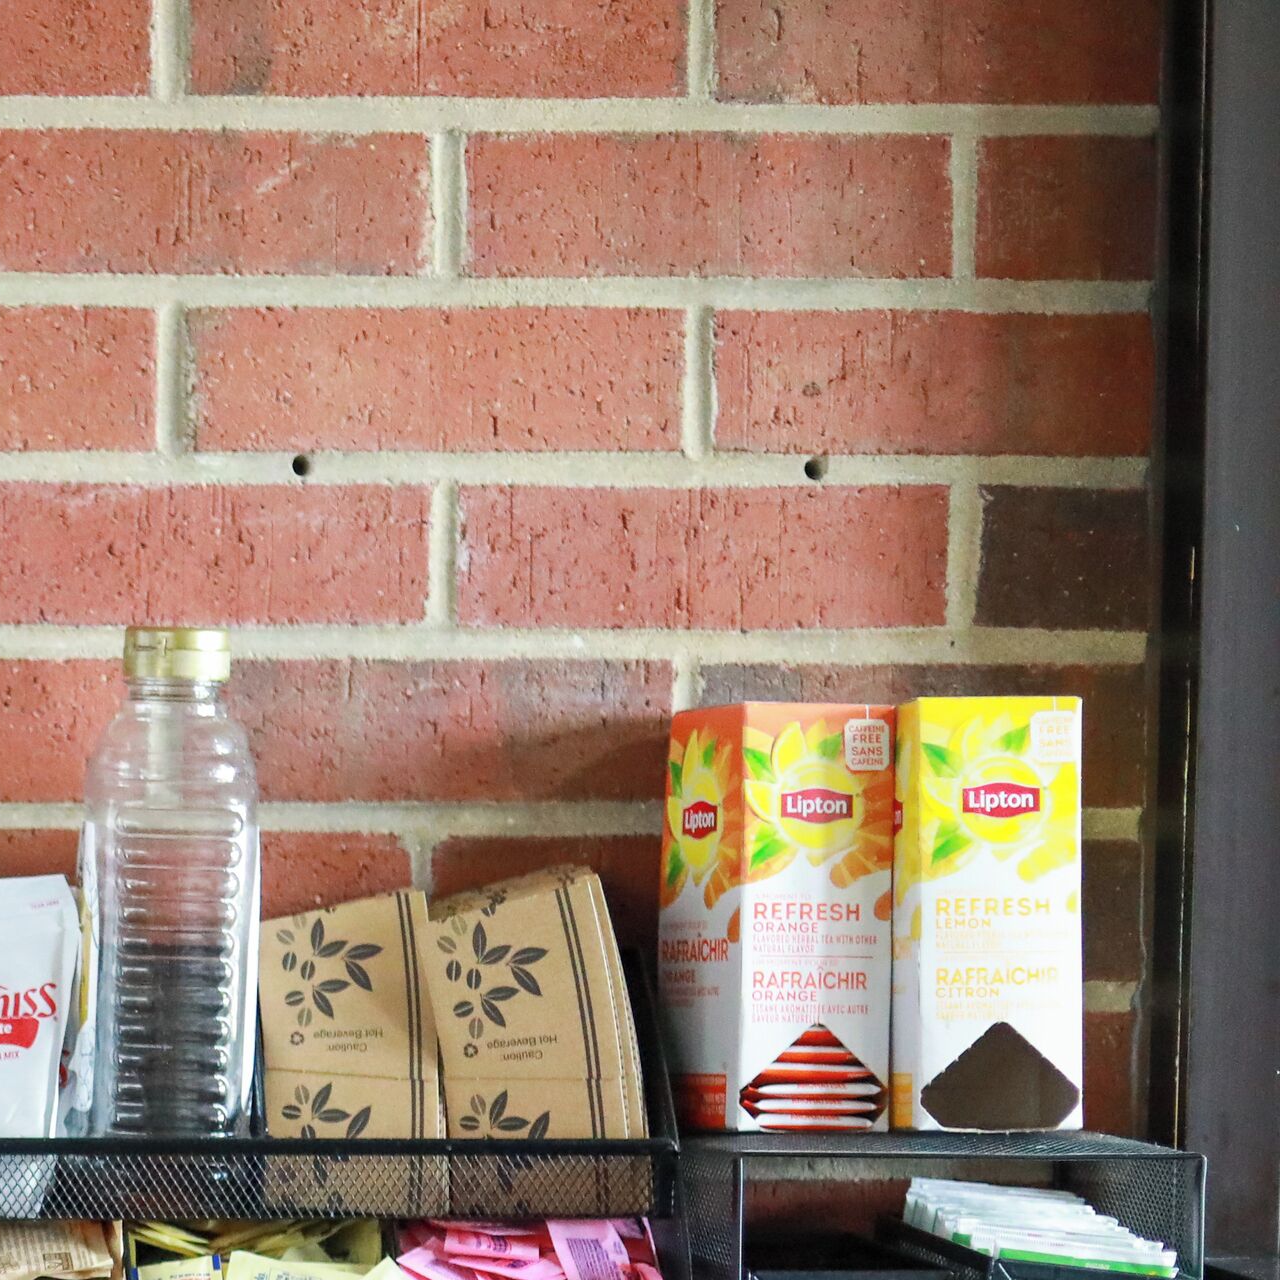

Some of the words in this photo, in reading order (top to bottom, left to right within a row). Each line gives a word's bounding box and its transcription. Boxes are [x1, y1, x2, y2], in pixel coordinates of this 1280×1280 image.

[852, 733, 882, 744] FREE
[851, 746, 884, 757] SANS
[785, 795, 847, 817] Lipton
[968, 790, 1034, 812] Lipton
[684, 807, 716, 832] Lipton
[753, 902, 861, 921] REFRESH
[936, 897, 1051, 917] REFRESH
[752, 922, 819, 933] ORANGE
[936, 918, 991, 929] LEMON
[821, 935, 834, 944] TEA
[855, 935, 878, 945] OTHER
[752, 966, 868, 990] RAFRAÎCHIR
[752, 990, 817, 1002] ORANGE
[936, 987, 1000, 998] CITRON
[313, 1028, 363, 1039] Beverage
[366, 1028, 384, 1038] Hot
[486, 1036, 537, 1049] Beverage
[540, 1034, 558, 1045] Hot
[3, 1051, 20, 1062] MIX
